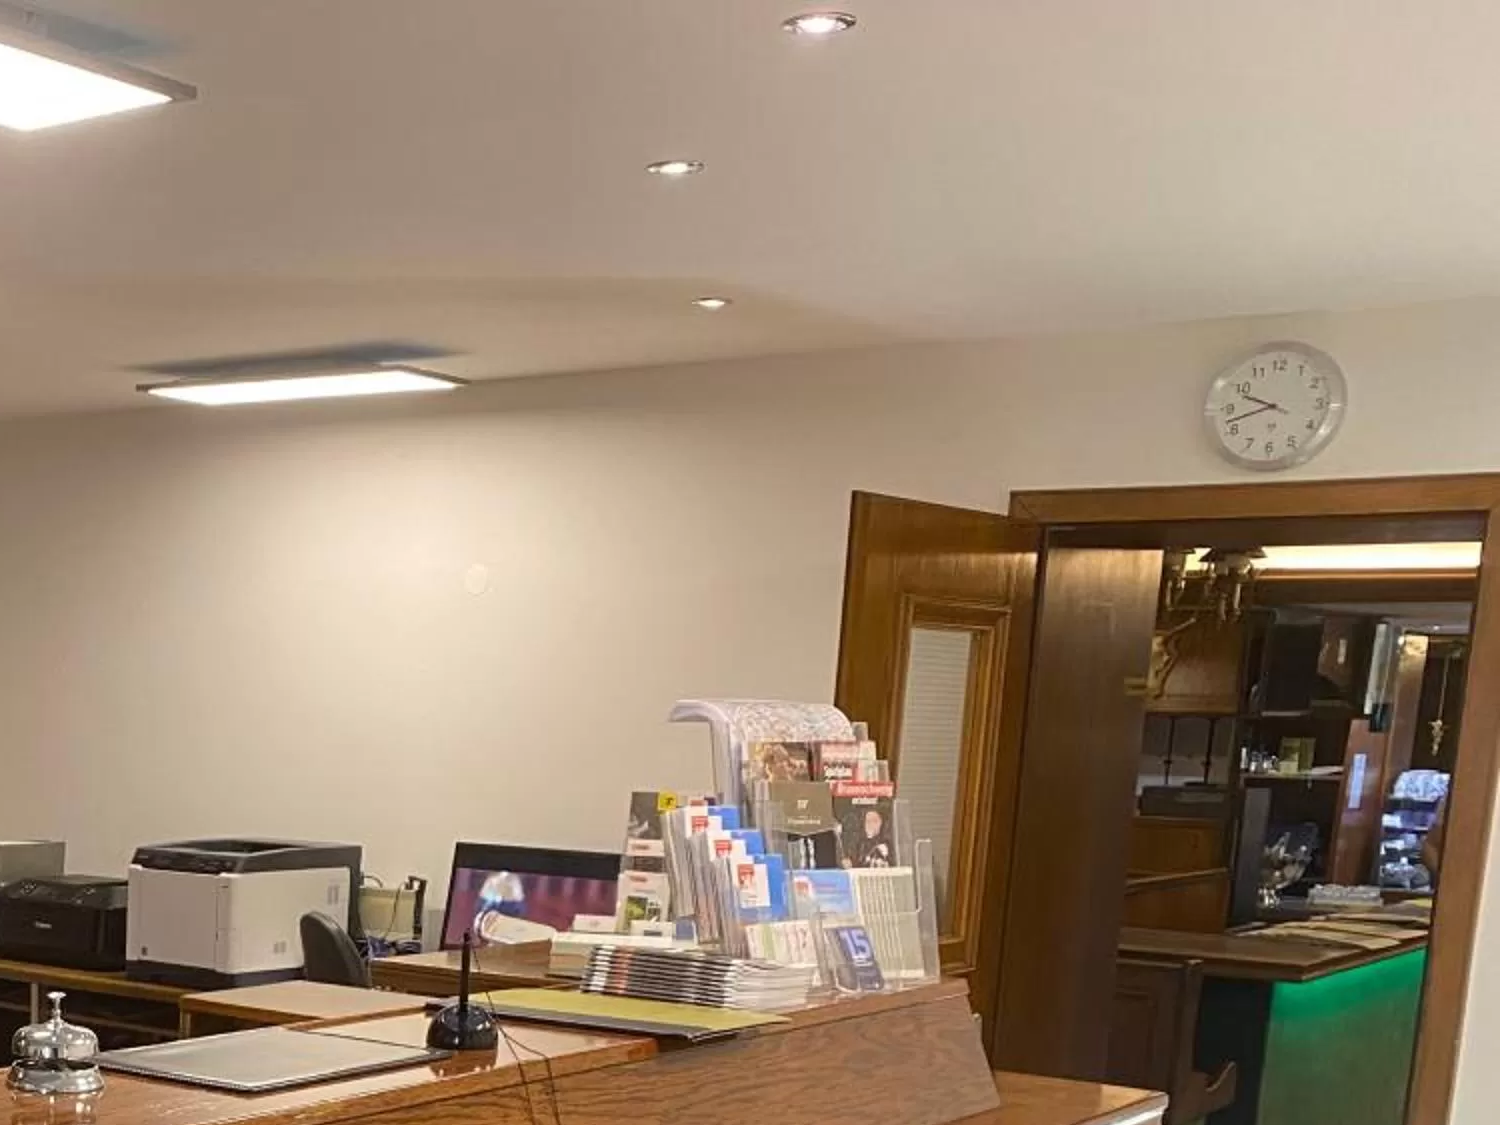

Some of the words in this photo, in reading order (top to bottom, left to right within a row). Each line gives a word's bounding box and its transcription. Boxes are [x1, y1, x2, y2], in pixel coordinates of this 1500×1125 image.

[1272, 358, 1288, 371] 12
[1252, 367, 1266, 377] 11
[1235, 381, 1251, 394] 10
[1244, 437, 1255, 449] 7
[838, 928, 872, 959] 15
